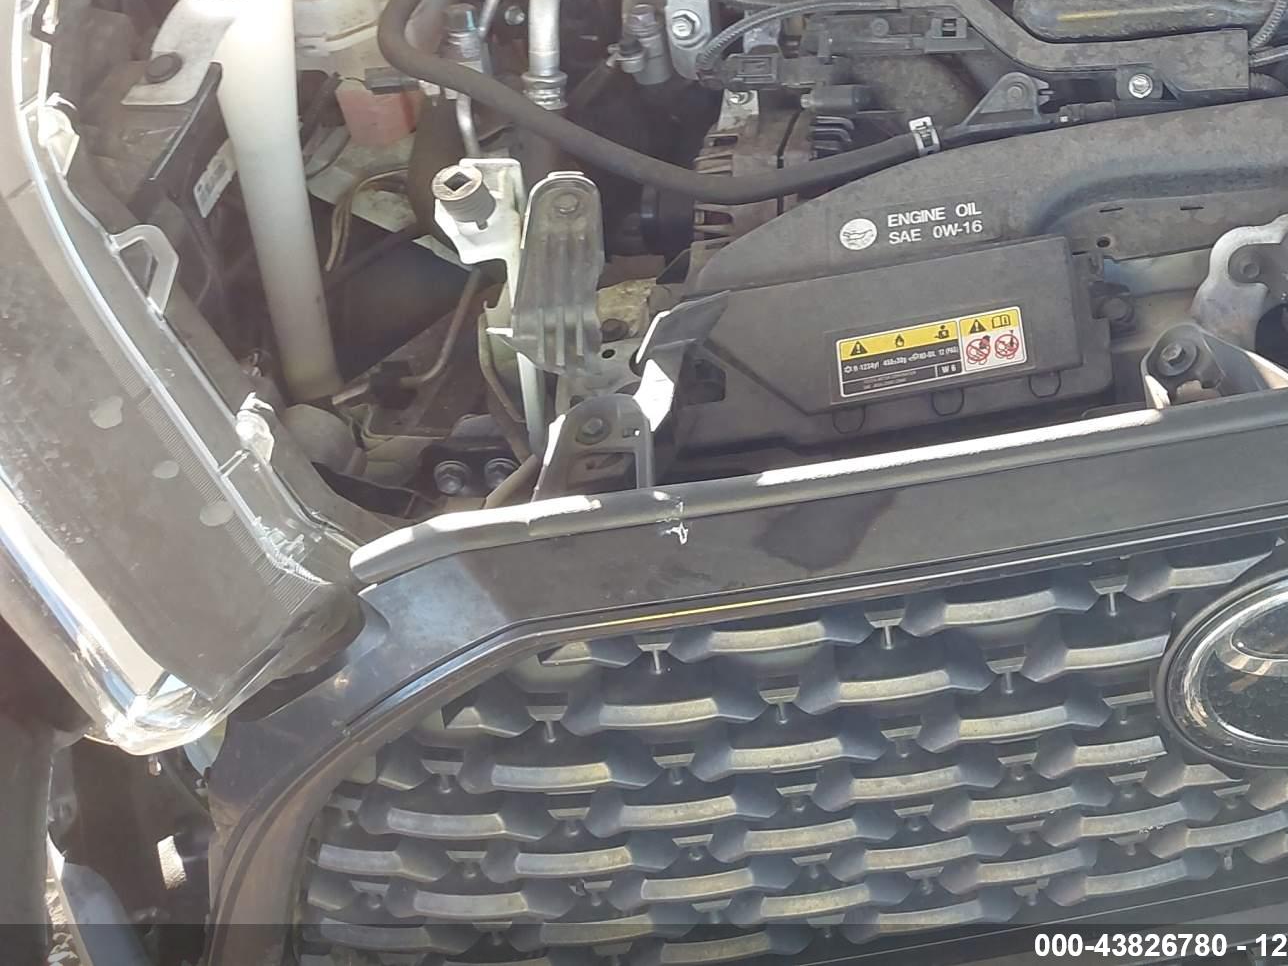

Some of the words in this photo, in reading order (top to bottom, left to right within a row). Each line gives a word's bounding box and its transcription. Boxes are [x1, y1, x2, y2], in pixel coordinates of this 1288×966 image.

[887, 207, 946, 228] ENGINE
[955, 202, 982, 218] OIL
[888, 228, 922, 245] SAE
[933, 219, 983, 239] 0W-16
